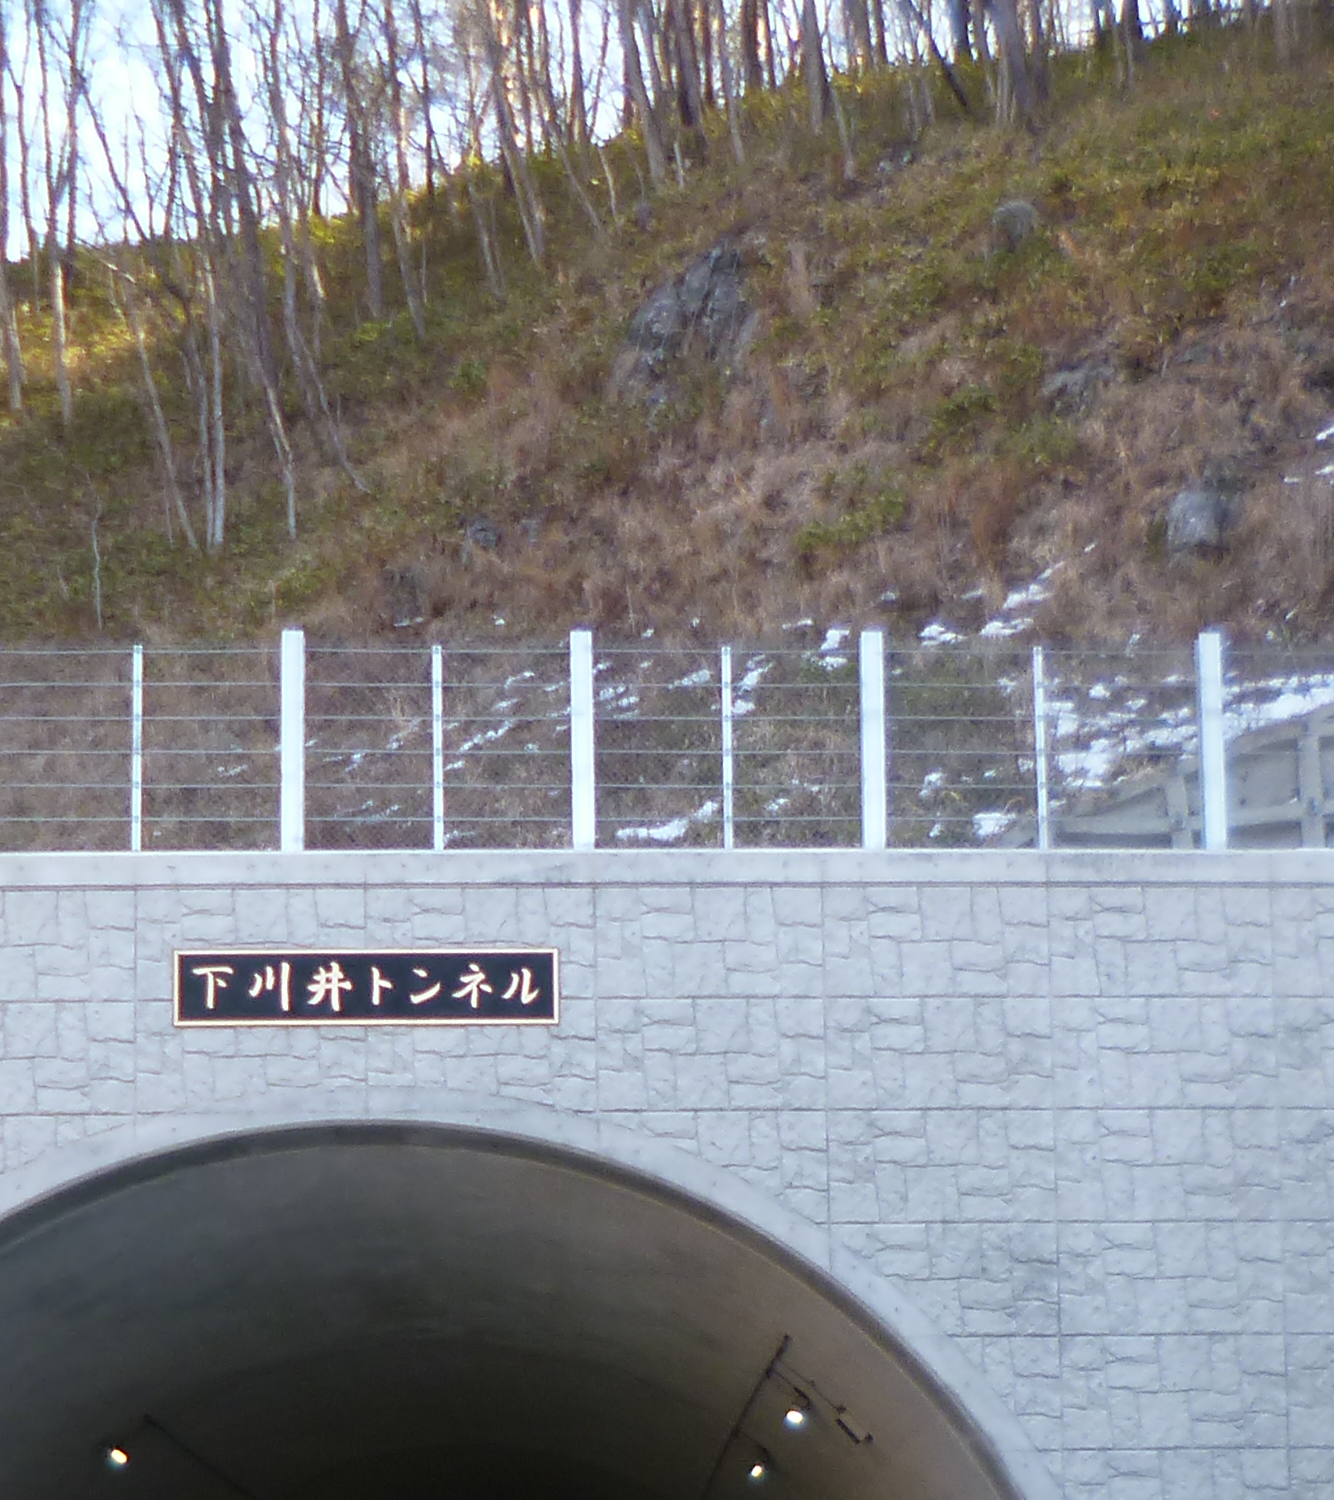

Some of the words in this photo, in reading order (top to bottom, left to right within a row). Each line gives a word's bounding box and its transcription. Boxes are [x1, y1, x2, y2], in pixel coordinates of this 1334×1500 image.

[192, 961, 539, 1011] 下川井トンネル
